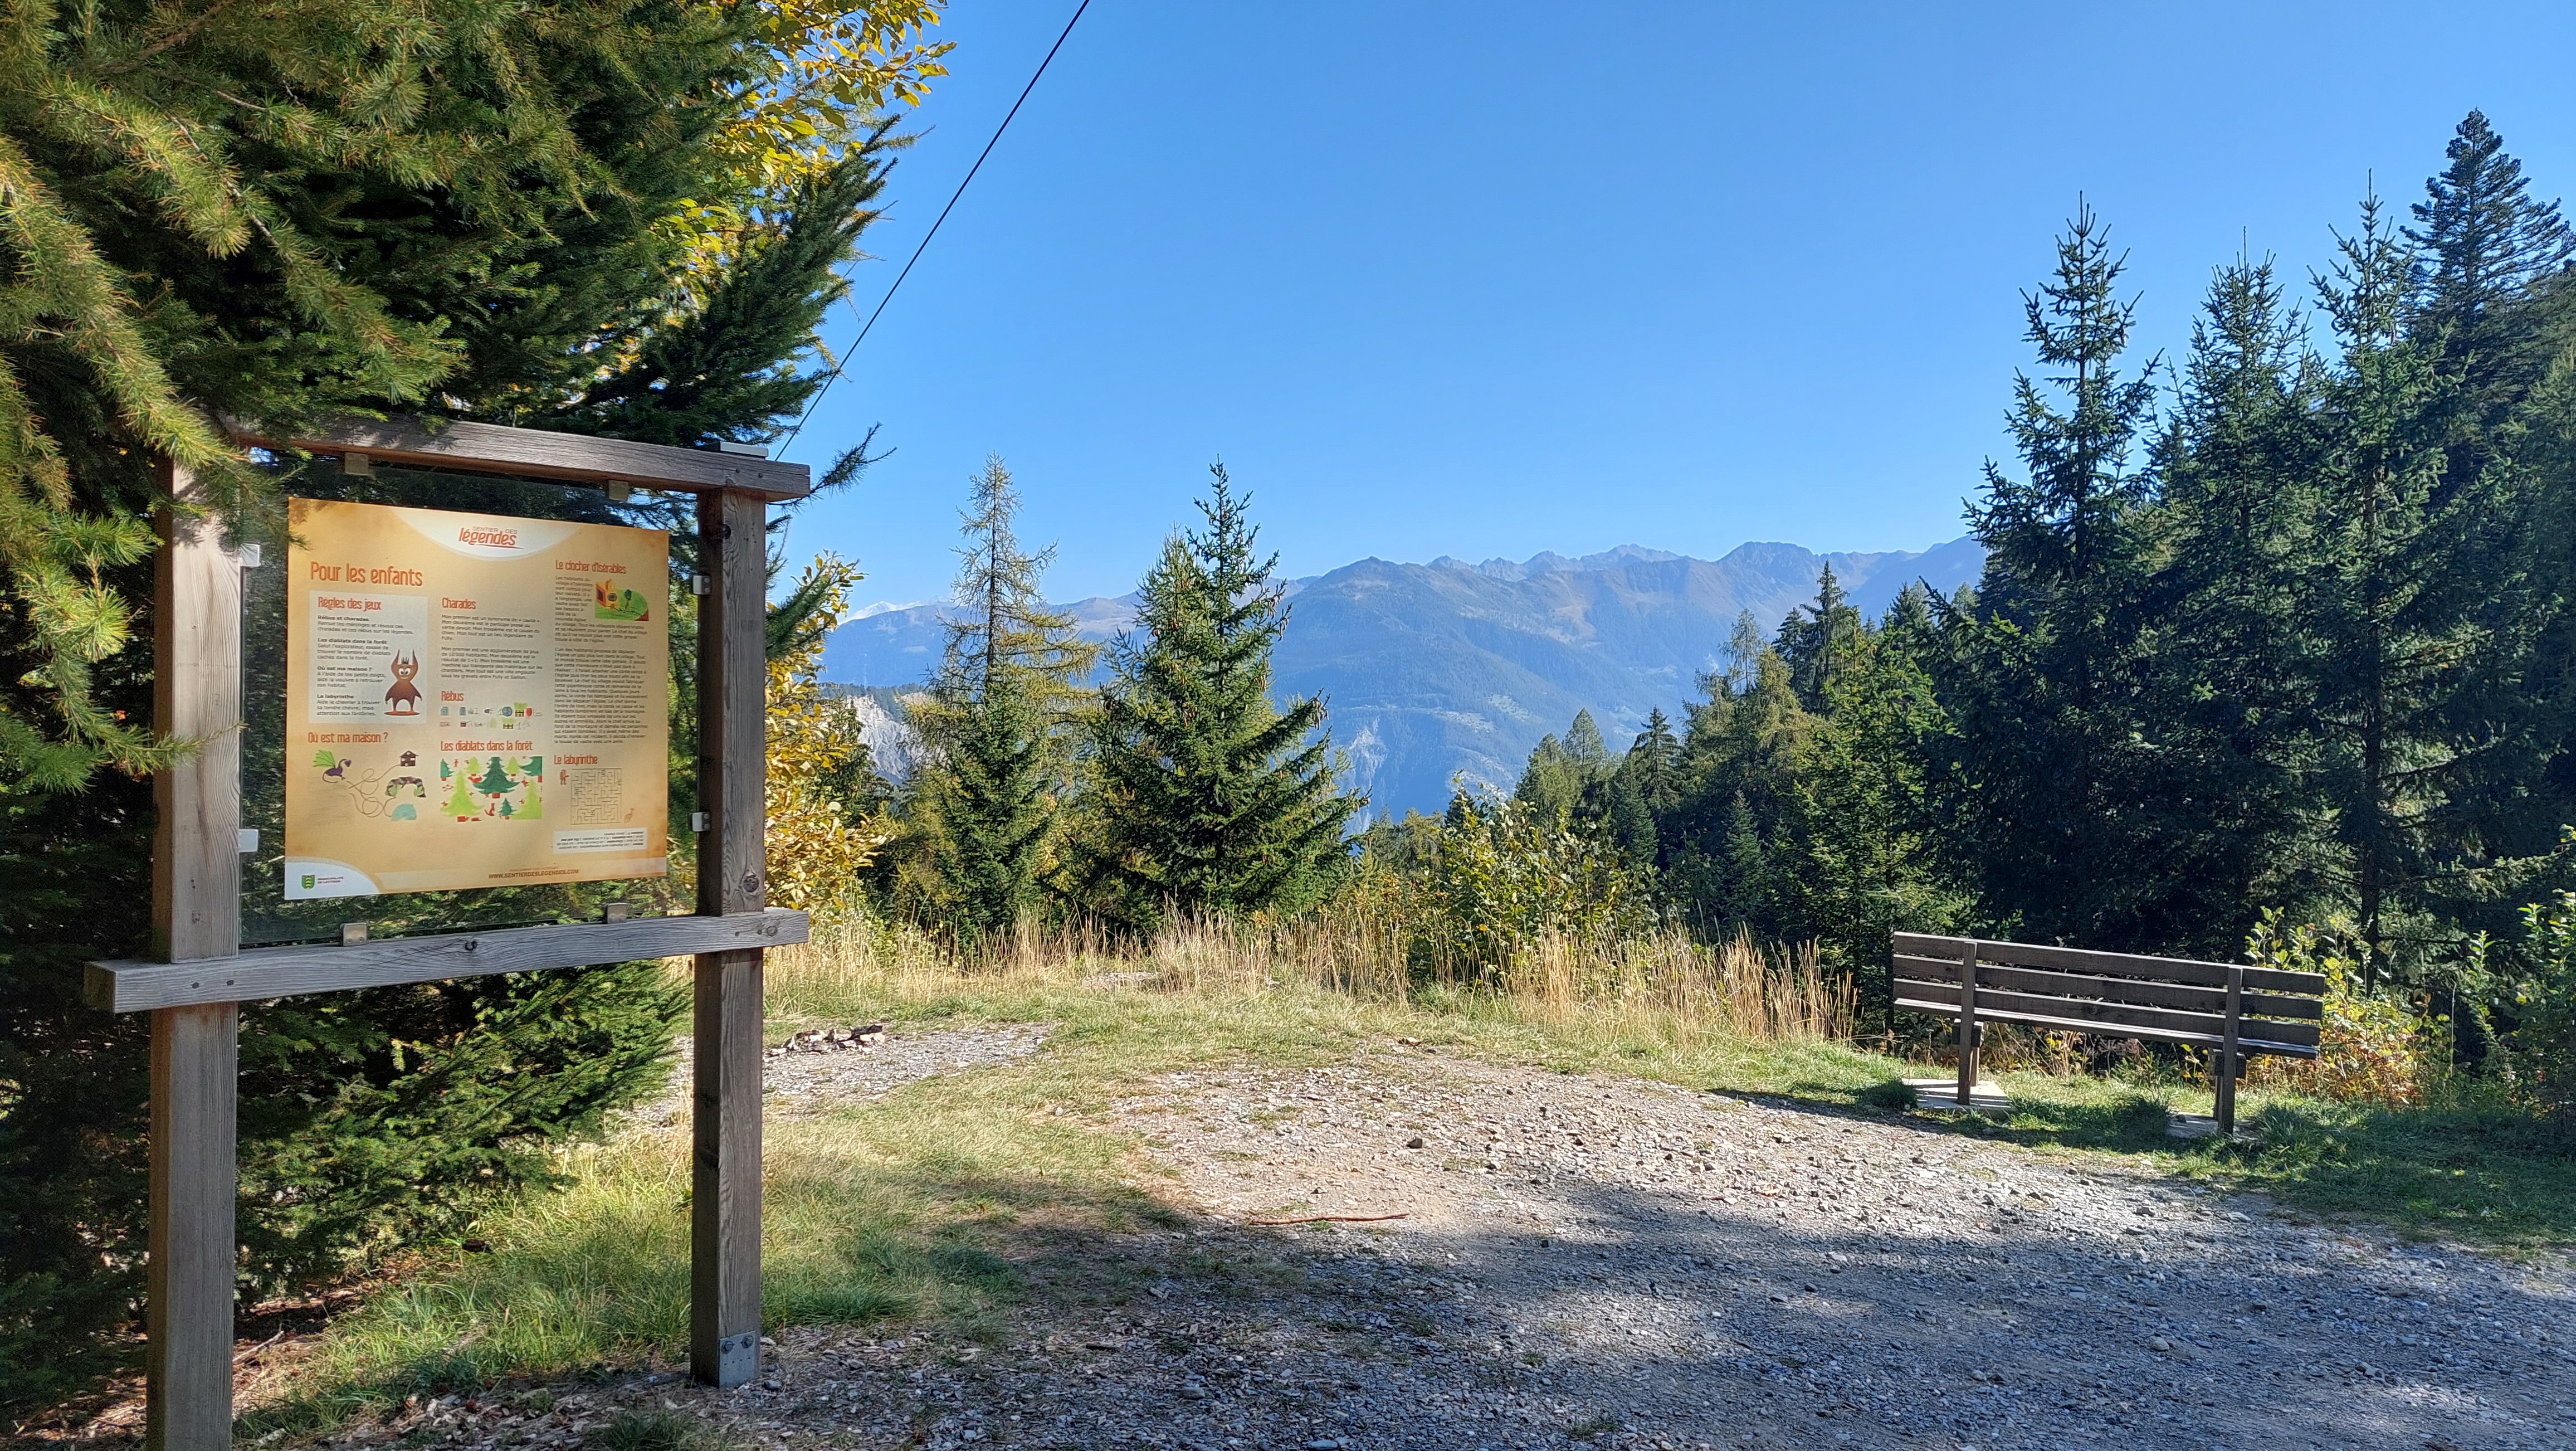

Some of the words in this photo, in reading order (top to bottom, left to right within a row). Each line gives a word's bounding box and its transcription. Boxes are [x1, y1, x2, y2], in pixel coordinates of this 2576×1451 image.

[458, 527, 516, 546] légendes
[555, 559, 563, 569] Le
[565, 561, 590, 572] clocher
[592, 562, 626, 574] d'Isérables
[310, 561, 341, 581] Pour
[346, 563, 366, 583] les
[370, 566, 423, 586] enfants
[318, 596, 345, 610] Règles
[348, 598, 362, 609] des
[363, 598, 382, 611] jeux
[442, 597, 476, 609] Charades
[441, 690, 464, 701] Rébus
[308, 732, 318, 743] Où
[320, 732, 335, 743] est
[337, 734, 350, 743] ma
[352, 732, 381, 743] maison
[383, 732, 388, 743] ?
[441, 741, 453, 751] Les
[455, 740, 485, 751] diablats
[487, 741, 504, 751] dans
[506, 741, 513, 751] la
[515, 740, 533, 751] forêt
[554, 754, 562, 765] Le
[564, 754, 598, 766] labyrinthe
[488, 869, 579, 879] WWW.SENTIERDESLEGENDES.COM
